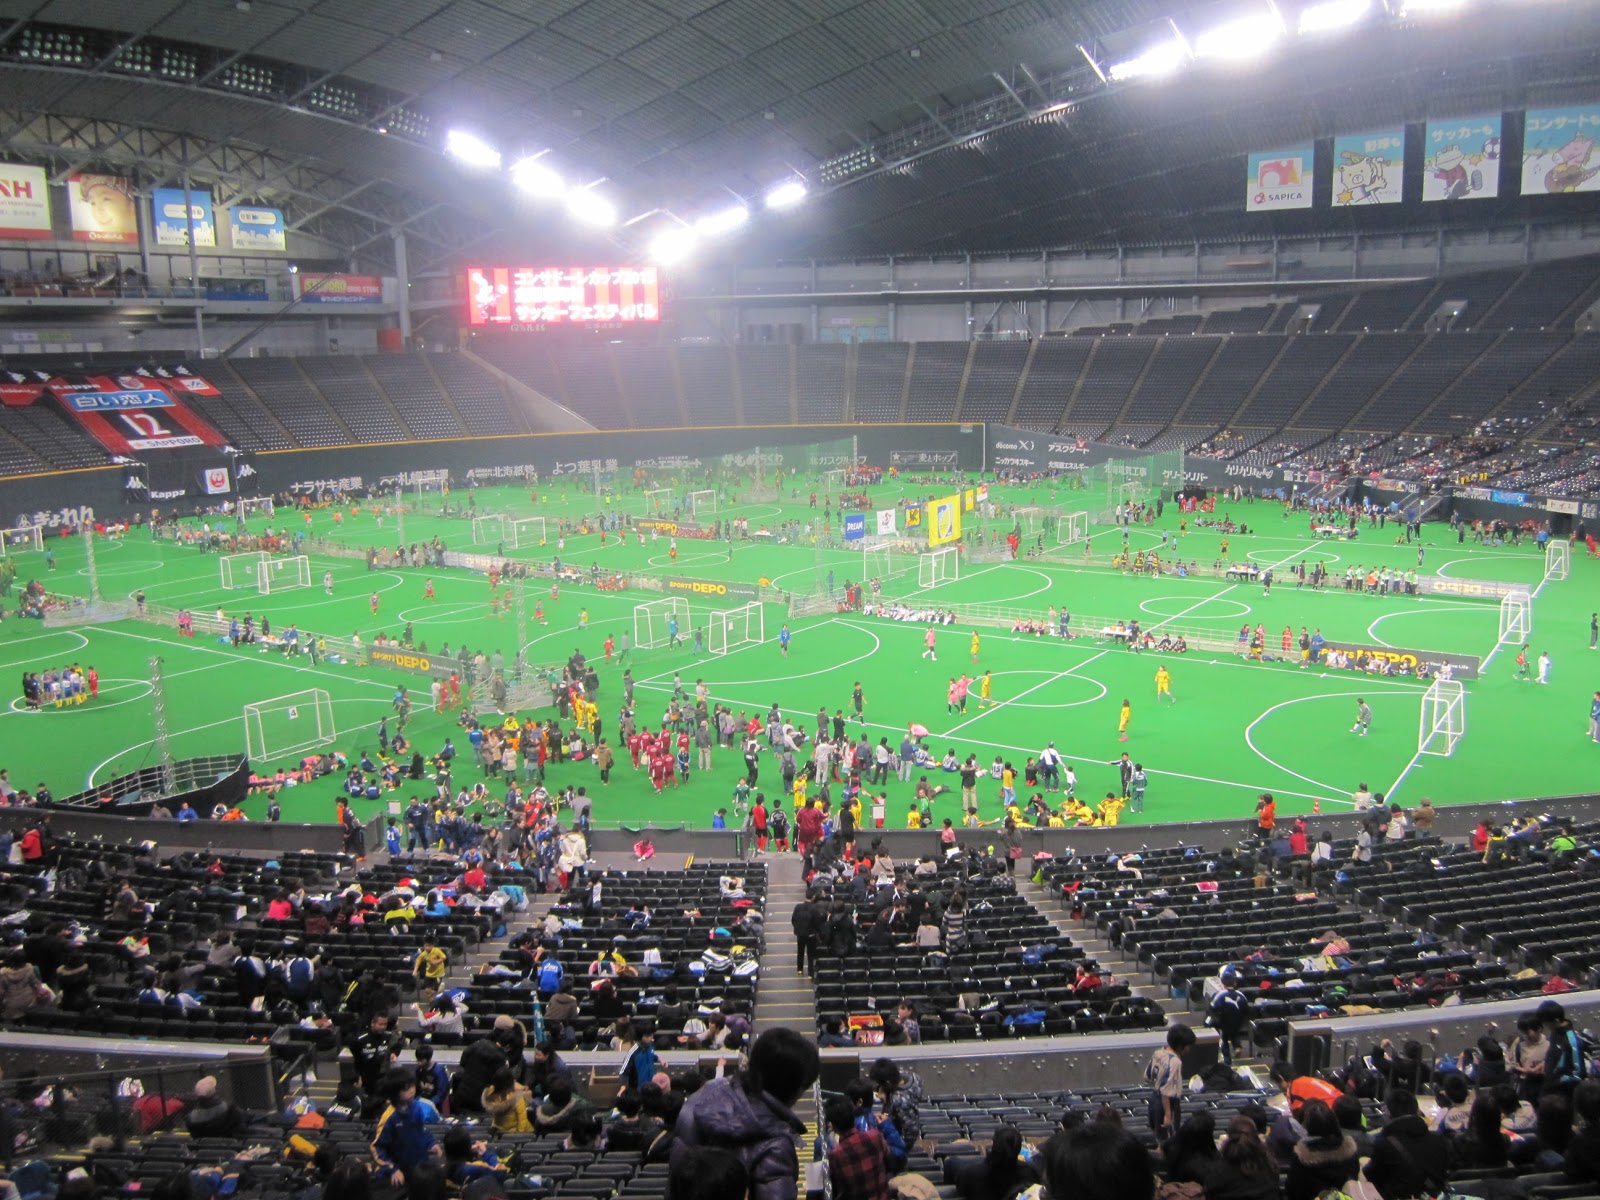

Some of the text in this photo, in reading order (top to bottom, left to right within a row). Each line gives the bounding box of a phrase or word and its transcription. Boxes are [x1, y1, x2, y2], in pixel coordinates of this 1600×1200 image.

[1431, 126, 1494, 142] サッカーも
[1268, 192, 1303, 202] SAPICA
[75, 393, 165, 408] 白い恋人
[120, 413, 172, 436] 12
[146, 437, 203, 448] SAPPORO
[995, 441, 1018, 450] docomo
[918, 452, 957, 463] 麦とホップ
[552, 459, 619, 475] よつ葉乳業
[290, 476, 363, 494] ナラサキ産業
[150, 489, 186, 499] Kappa
[33, 505, 96, 528] ぎょれん
[669, 581, 692, 589] SPORTS
[692, 582, 727, 595] DEPO
[372, 651, 396, 662] SPORTS
[396, 654, 430, 671] DEPO
